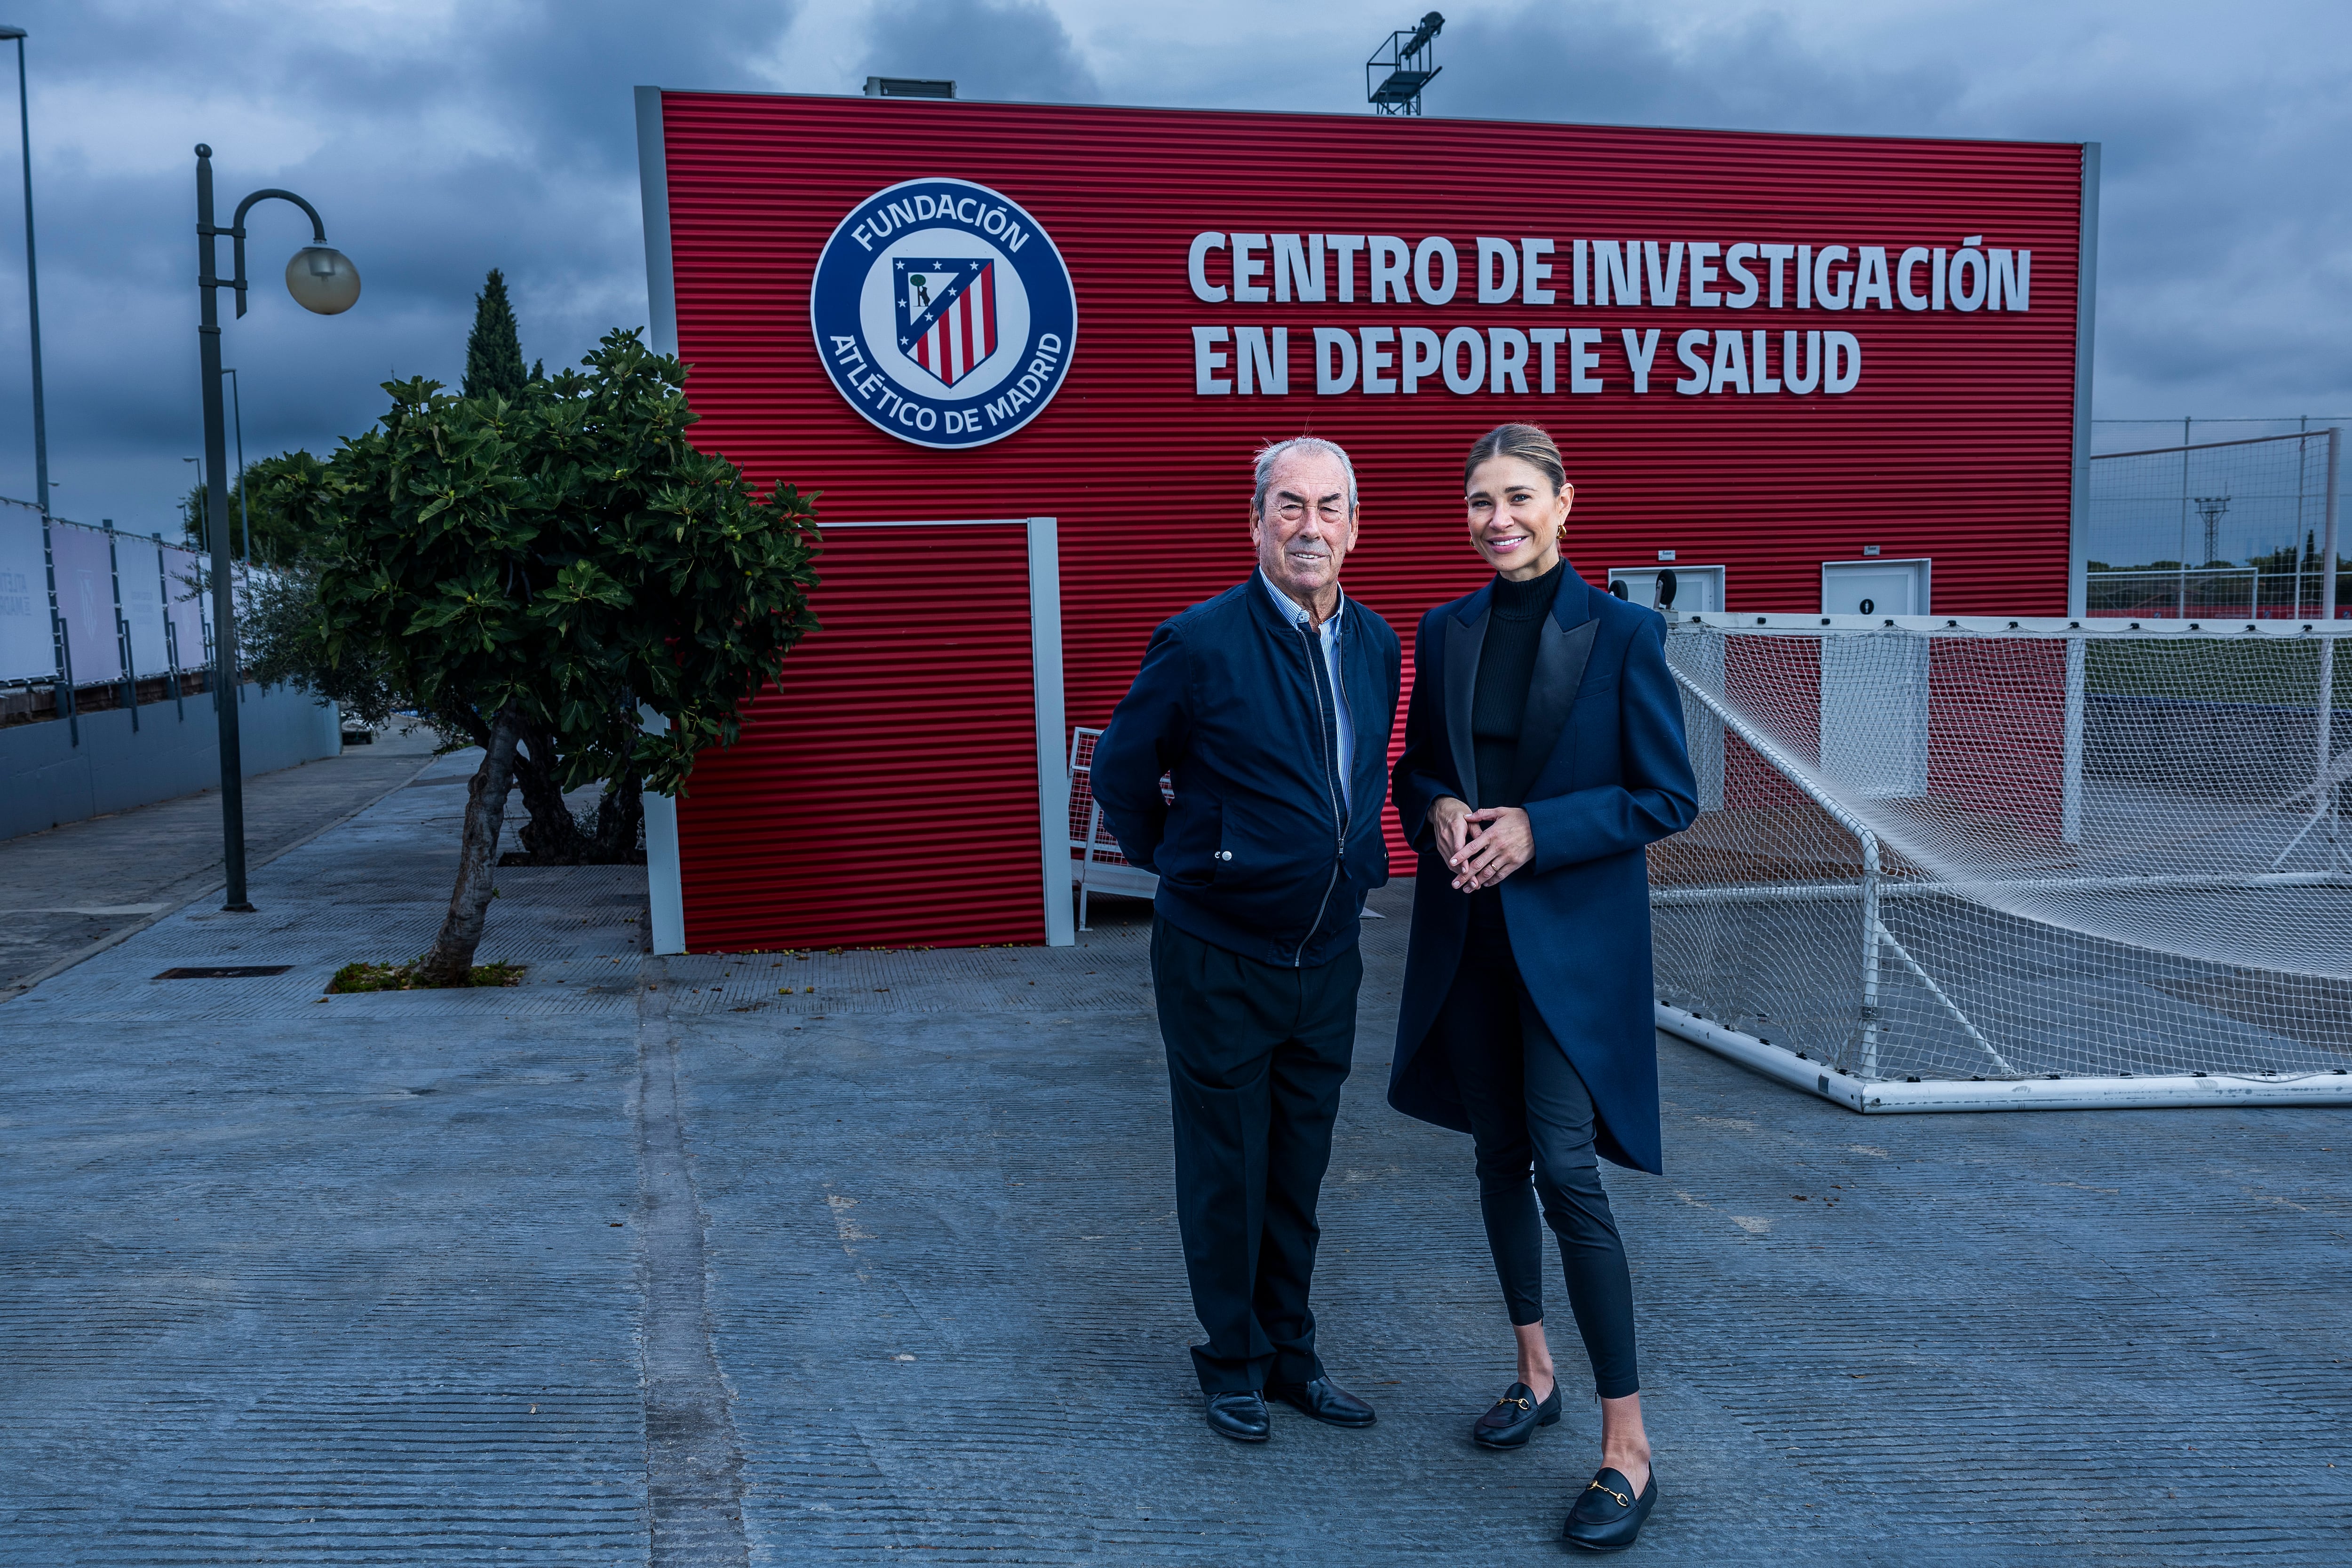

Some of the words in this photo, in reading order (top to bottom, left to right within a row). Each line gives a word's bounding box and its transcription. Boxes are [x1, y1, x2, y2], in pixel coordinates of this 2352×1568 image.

[850, 194, 1030, 253] FUNDACIÓN
[1188, 231, 1459, 305] CENTRO
[1476, 237, 1556, 306] DE
[1573, 235, 2031, 311] INVESTIGACIÓN
[830, 334, 937, 431] ATLÉTICO
[944, 408, 983, 434] DE
[984, 333, 1061, 427] MADRID
[1192, 326, 1288, 395] EN
[1313, 326, 1603, 395] DEPORTE
[1621, 329, 1661, 394] Y
[1676, 329, 1861, 395] SALUD
